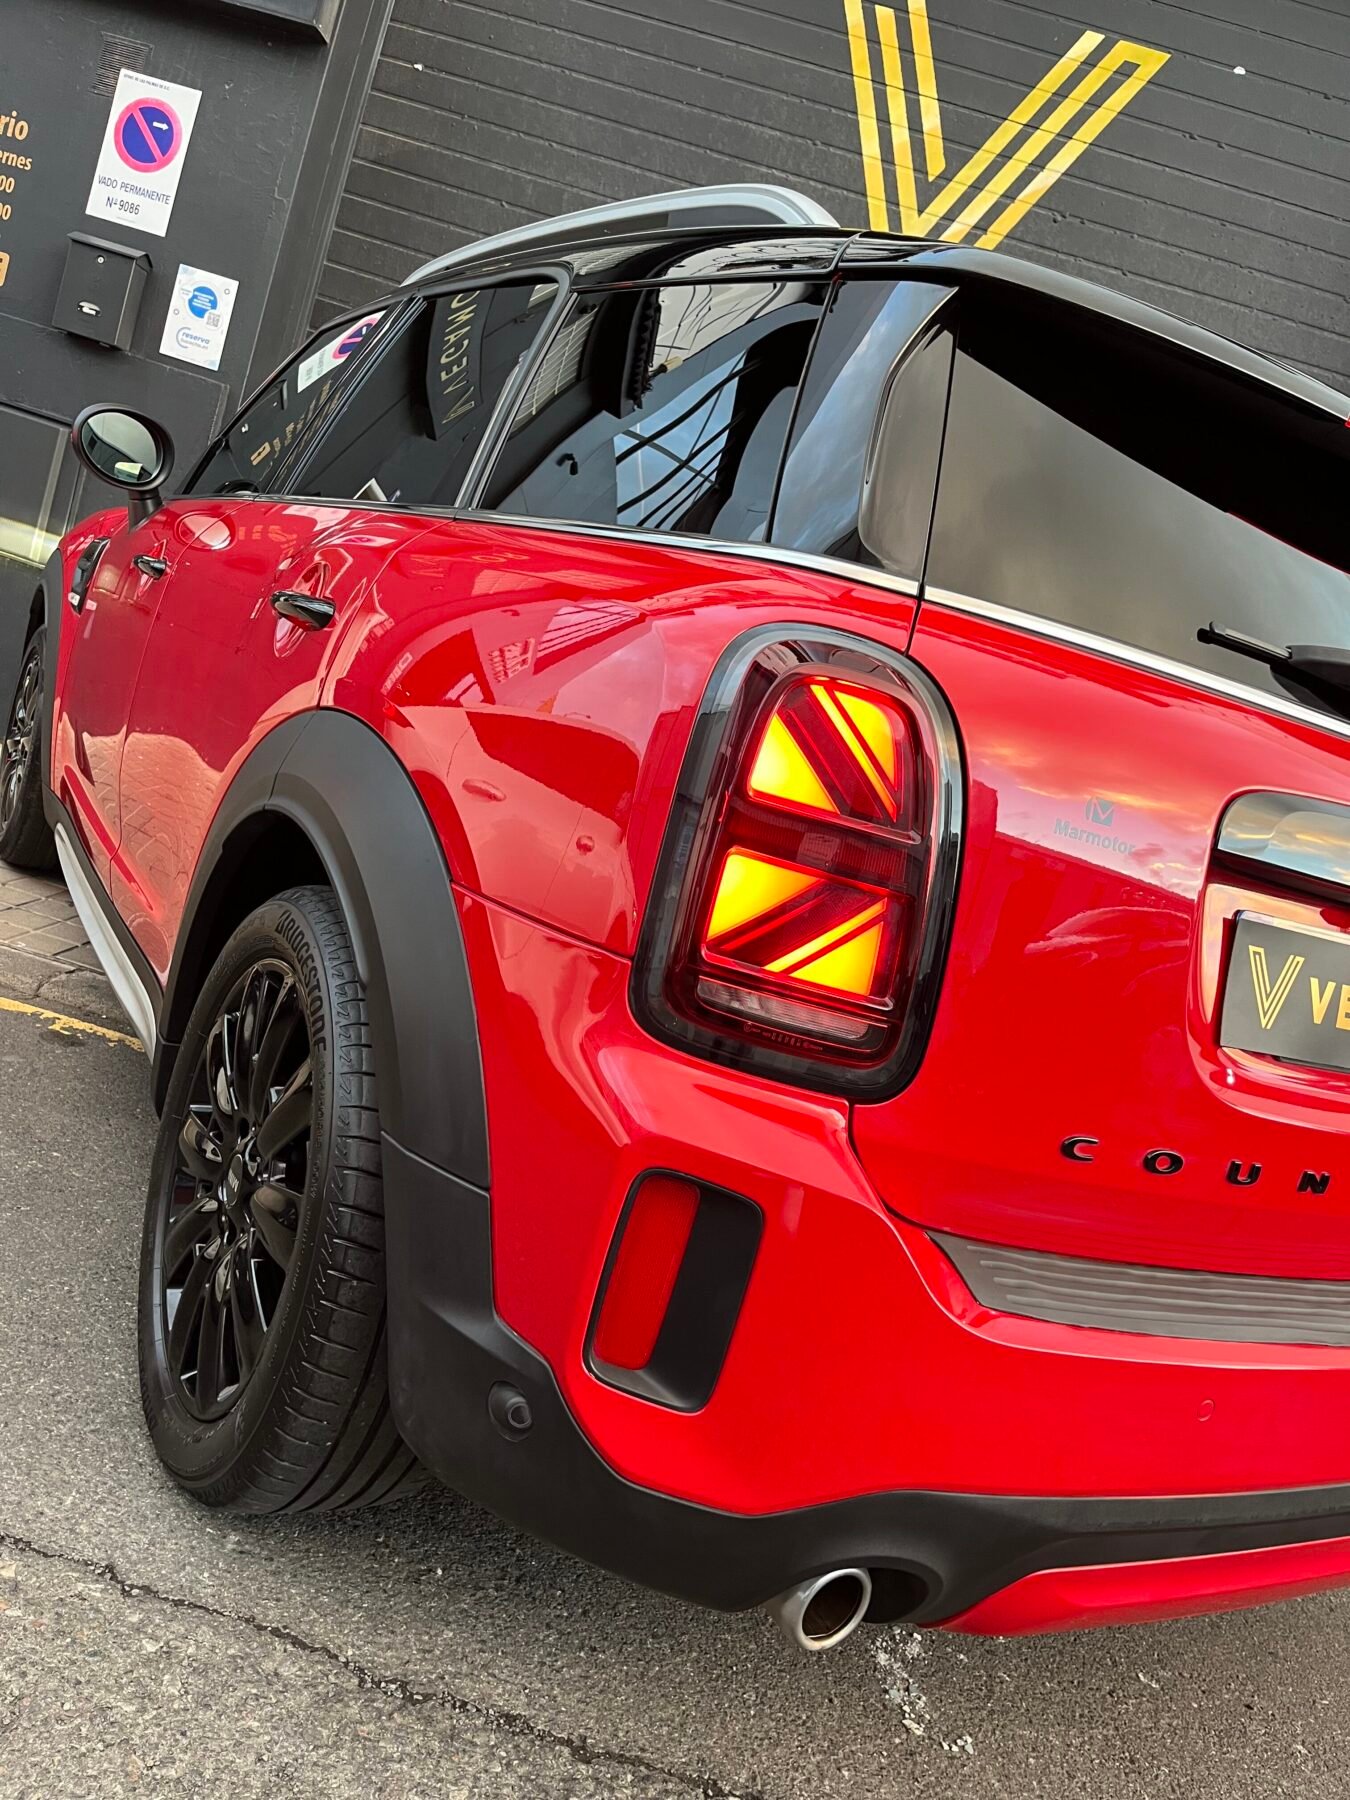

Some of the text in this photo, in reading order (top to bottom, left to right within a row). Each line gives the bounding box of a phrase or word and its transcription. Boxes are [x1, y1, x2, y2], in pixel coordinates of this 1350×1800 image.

[98, 174, 171, 205] VADO PERMANENTE
[1053, 817, 1136, 856] Marmotor
